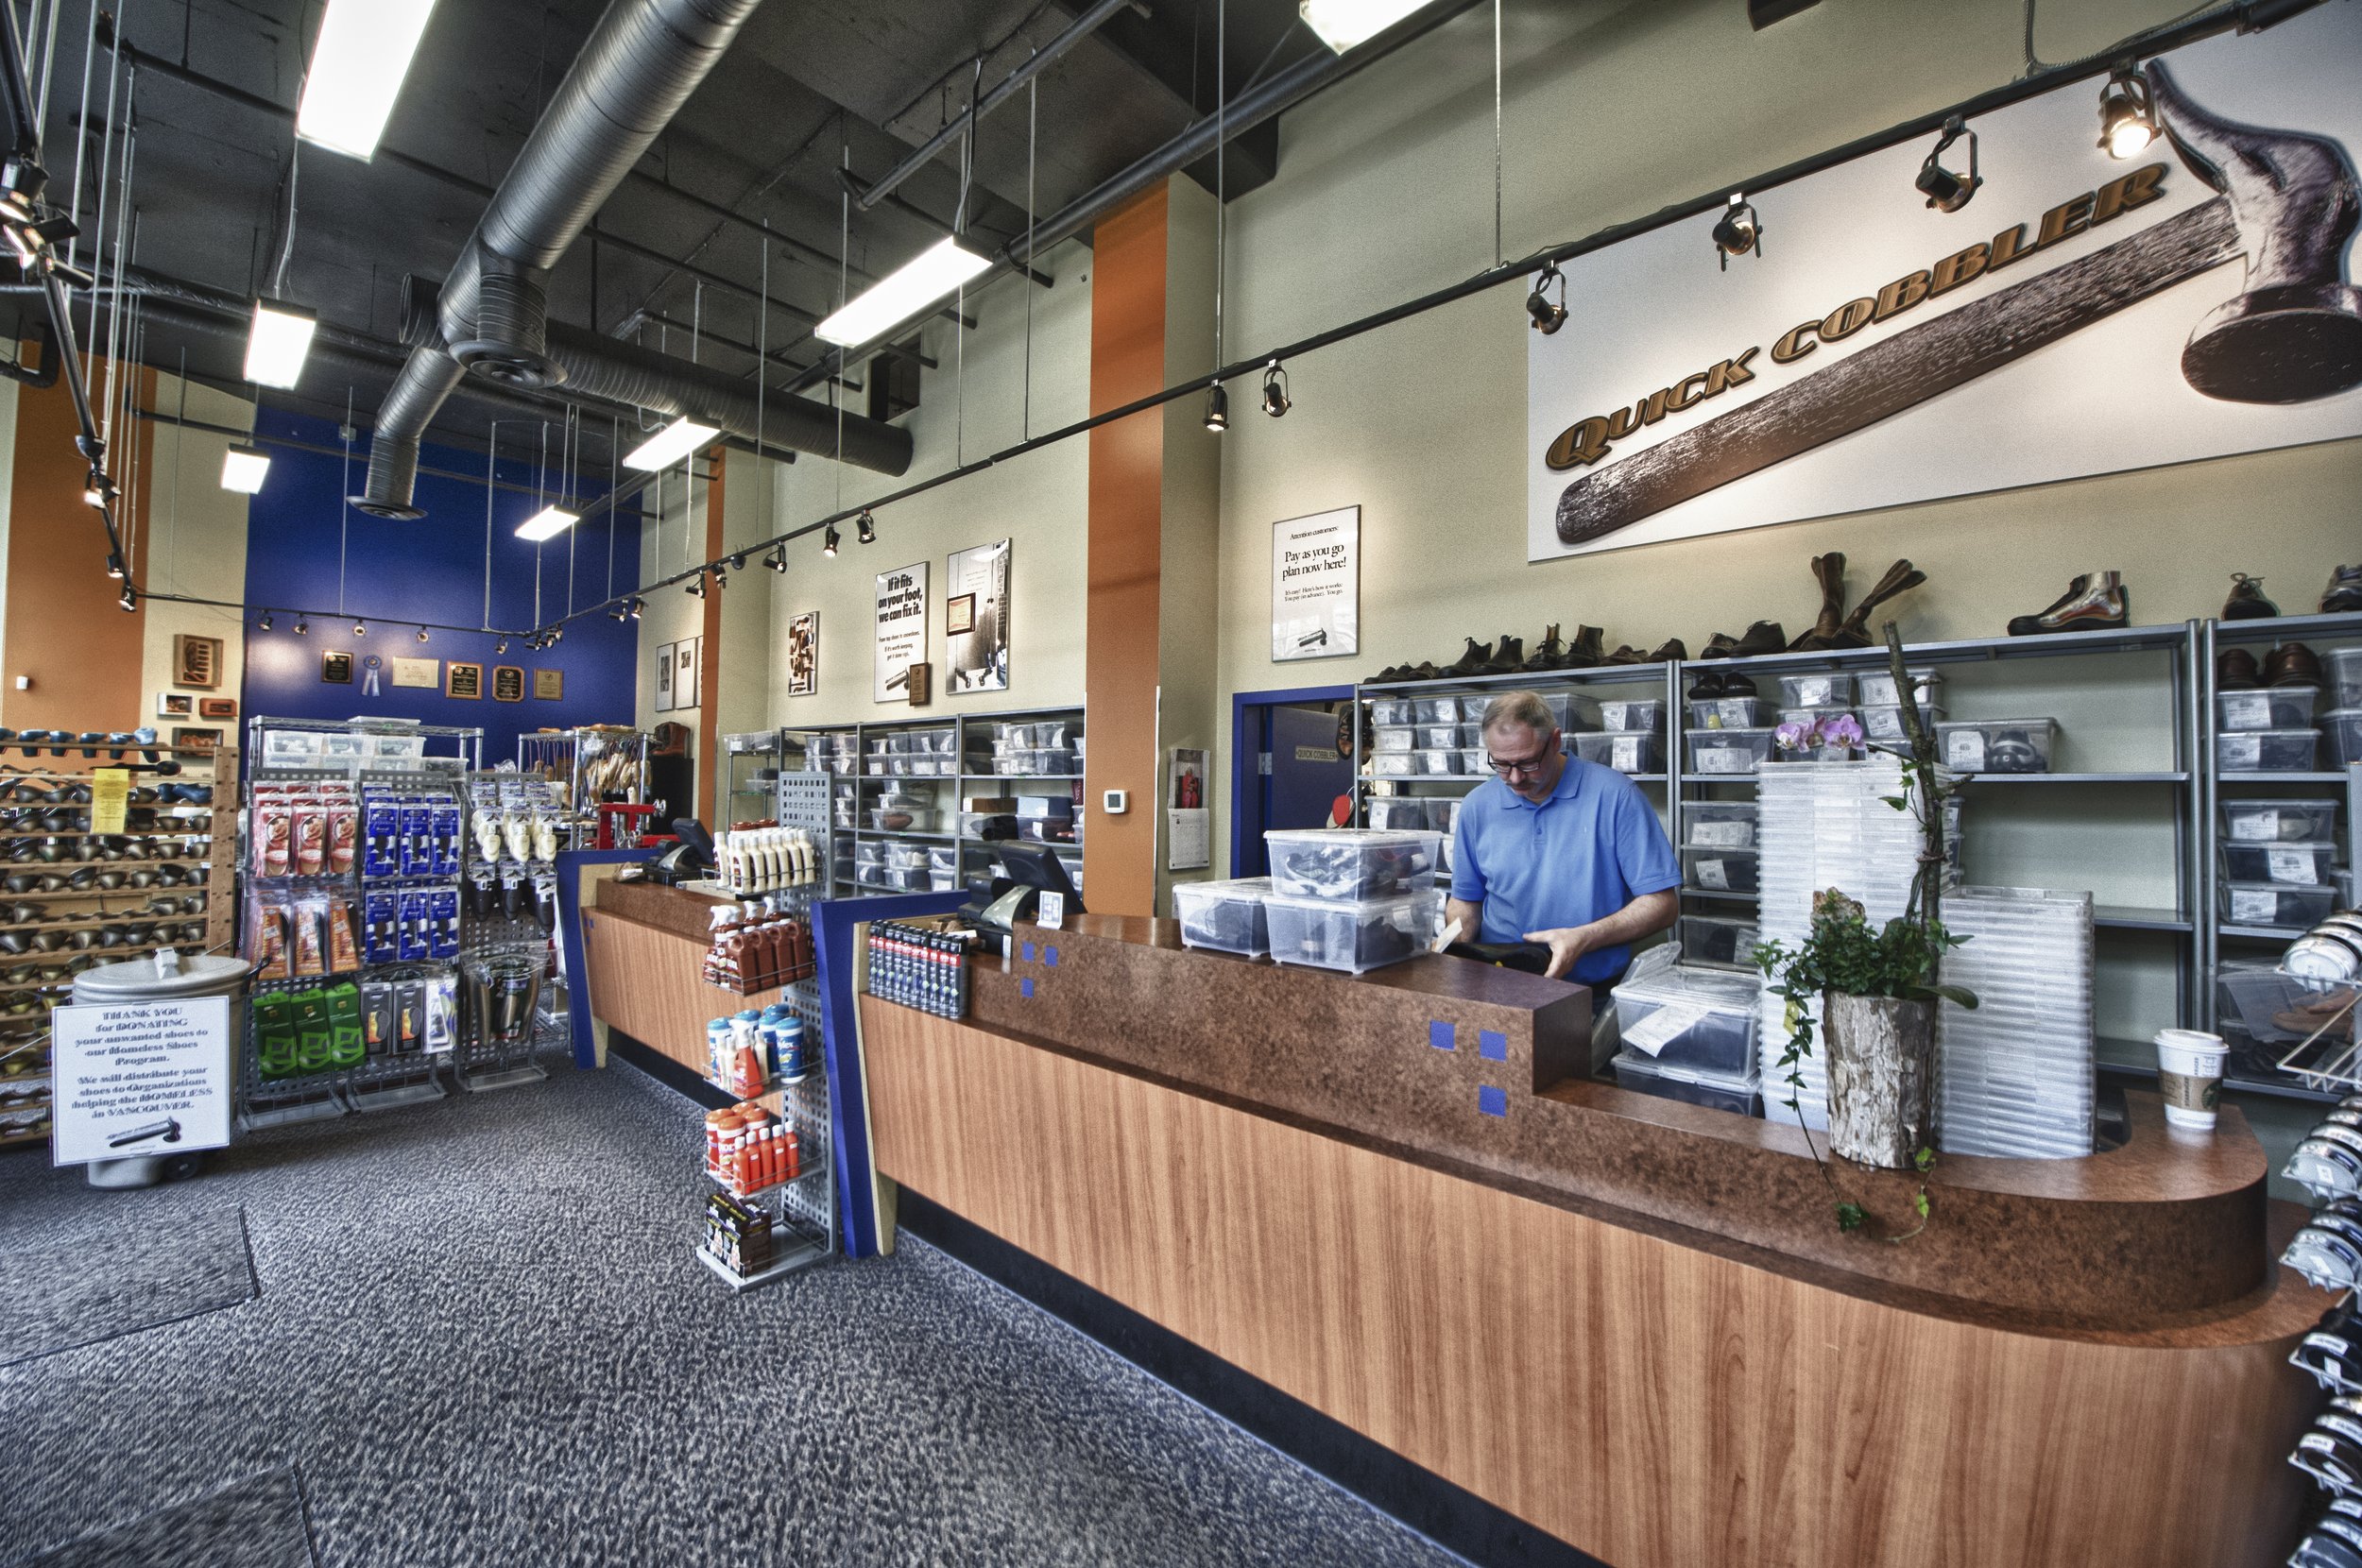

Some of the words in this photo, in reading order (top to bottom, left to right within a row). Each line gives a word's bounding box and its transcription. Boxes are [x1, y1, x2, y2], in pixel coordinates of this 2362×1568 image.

[1546, 346, 1761, 470] QUICK
[1771, 162, 2171, 364] COBBLER
[1290, 531, 1312, 540] Attention
[1285, 551, 1300, 564] Pay
[1302, 550, 1310, 559] as
[1312, 547, 1329, 561] you
[1331, 544, 1344, 557] go
[1282, 566, 1300, 581] plan
[1302, 563, 1322, 574] now
[1324, 556, 1346, 571] here!
[887, 575, 894, 591] If
[894, 576, 900, 589] it
[900, 573, 913, 588] fits
[879, 598, 887, 608] on
[887, 593, 904, 609] your
[904, 588, 923, 602] foot,
[879, 612, 889, 623] we
[889, 608, 902, 621] can
[902, 604, 913, 618] fix
[913, 602, 922, 615] it.
[102, 1009, 150, 1020] THANK
[154, 1007, 182, 1016] YOU
[95, 1024, 113, 1032] for
[116, 1018, 188, 1031] DONATING
[75, 1037, 103, 1048] your
[105, 1031, 162, 1043] unwanted
[164, 1029, 195, 1039] shoes
[109, 1044, 163, 1055] Homeless
[166, 1041, 198, 1049] Shoes
[115, 1055, 170, 1066] Program.
[77, 1076, 97, 1085] We
[99, 1073, 122, 1082] will
[123, 1069, 180, 1082] distribute
[181, 1067, 209, 1078] your
[79, 1086, 111, 1096] shoes
[127, 1079, 207, 1093] Organizations
[72, 1098, 116, 1109] helping
[118, 1096, 137, 1104] the
[139, 1087, 214, 1102] HOMELESS
[107, 1101, 195, 1116] VANCOUVER.
